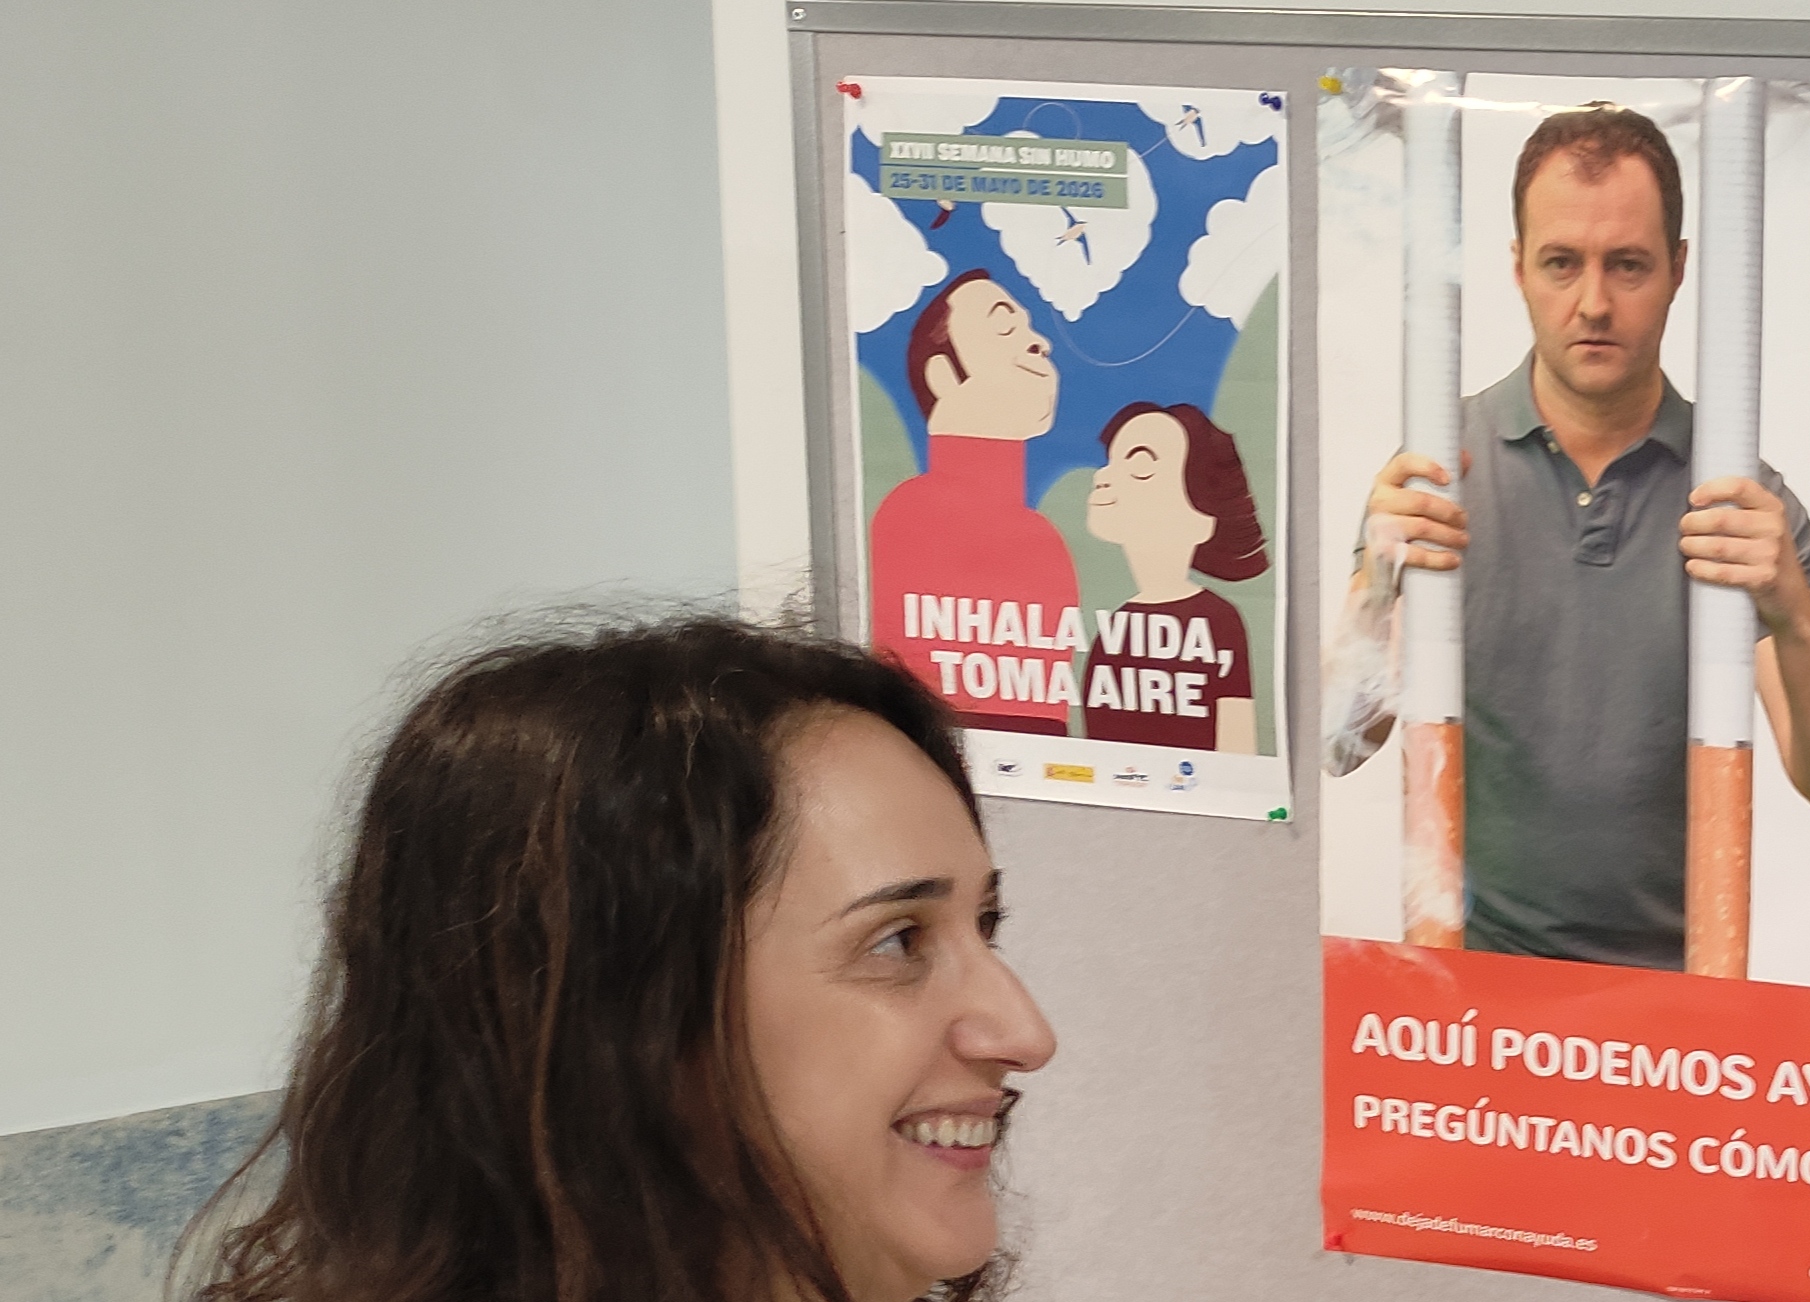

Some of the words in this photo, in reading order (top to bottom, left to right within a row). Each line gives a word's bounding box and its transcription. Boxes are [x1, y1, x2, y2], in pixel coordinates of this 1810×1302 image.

[890, 172, 938, 190] 25-31
[941, 174, 966, 192] DE
[970, 176, 1022, 194] MAYO
[1026, 178, 1052, 196] DE
[1055, 180, 1105, 199] 2026
[937, 143, 1018, 164] SEMANA
[1018, 146, 1053, 165] SIN
[1055, 149, 1116, 169] HUMO
[903, 593, 1089, 653] INHALA
[1095, 608, 1235, 678] VIDA,
[929, 650, 1081, 707] TOMA
[1087, 664, 1209, 718] AIRE
[1351, 1008, 1480, 1067] AQUÍ
[1490, 1027, 1757, 1100] PODEMOS
[1352, 1094, 1678, 1170] PREGÚNTANOS
[1350, 1207, 1599, 1252] www.dejadefumarconayuda.es
